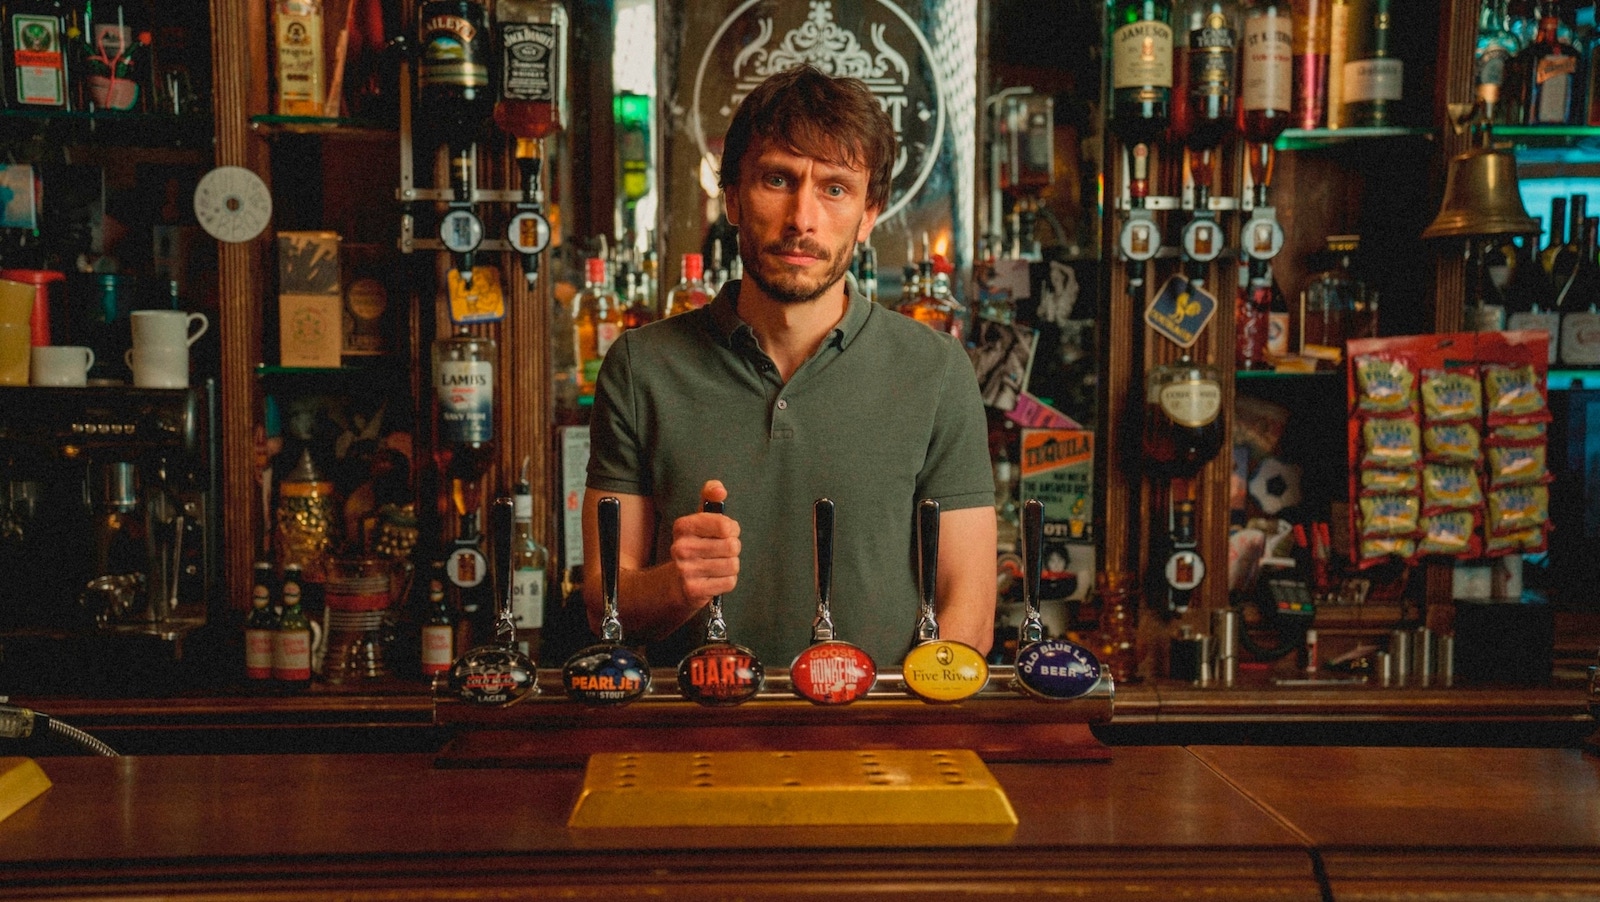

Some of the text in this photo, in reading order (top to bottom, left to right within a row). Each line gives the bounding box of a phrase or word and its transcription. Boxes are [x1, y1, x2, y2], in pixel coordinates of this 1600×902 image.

[1120, 25, 1169, 41] JAMESON
[1027, 435, 1090, 468] TEQUILA
[810, 650, 856, 659] GOOSE
[1024, 643, 1093, 678] OLD BLUE LAST
[691, 655, 752, 686] DARK
[810, 659, 858, 684] HONKERS
[913, 669, 980, 682] Five Rivers
[1041, 665, 1077, 678] BEER
[572, 676, 640, 690] PEARL JET
[478, 694, 507, 702] LAGER
[600, 691, 626, 699] STOUT
